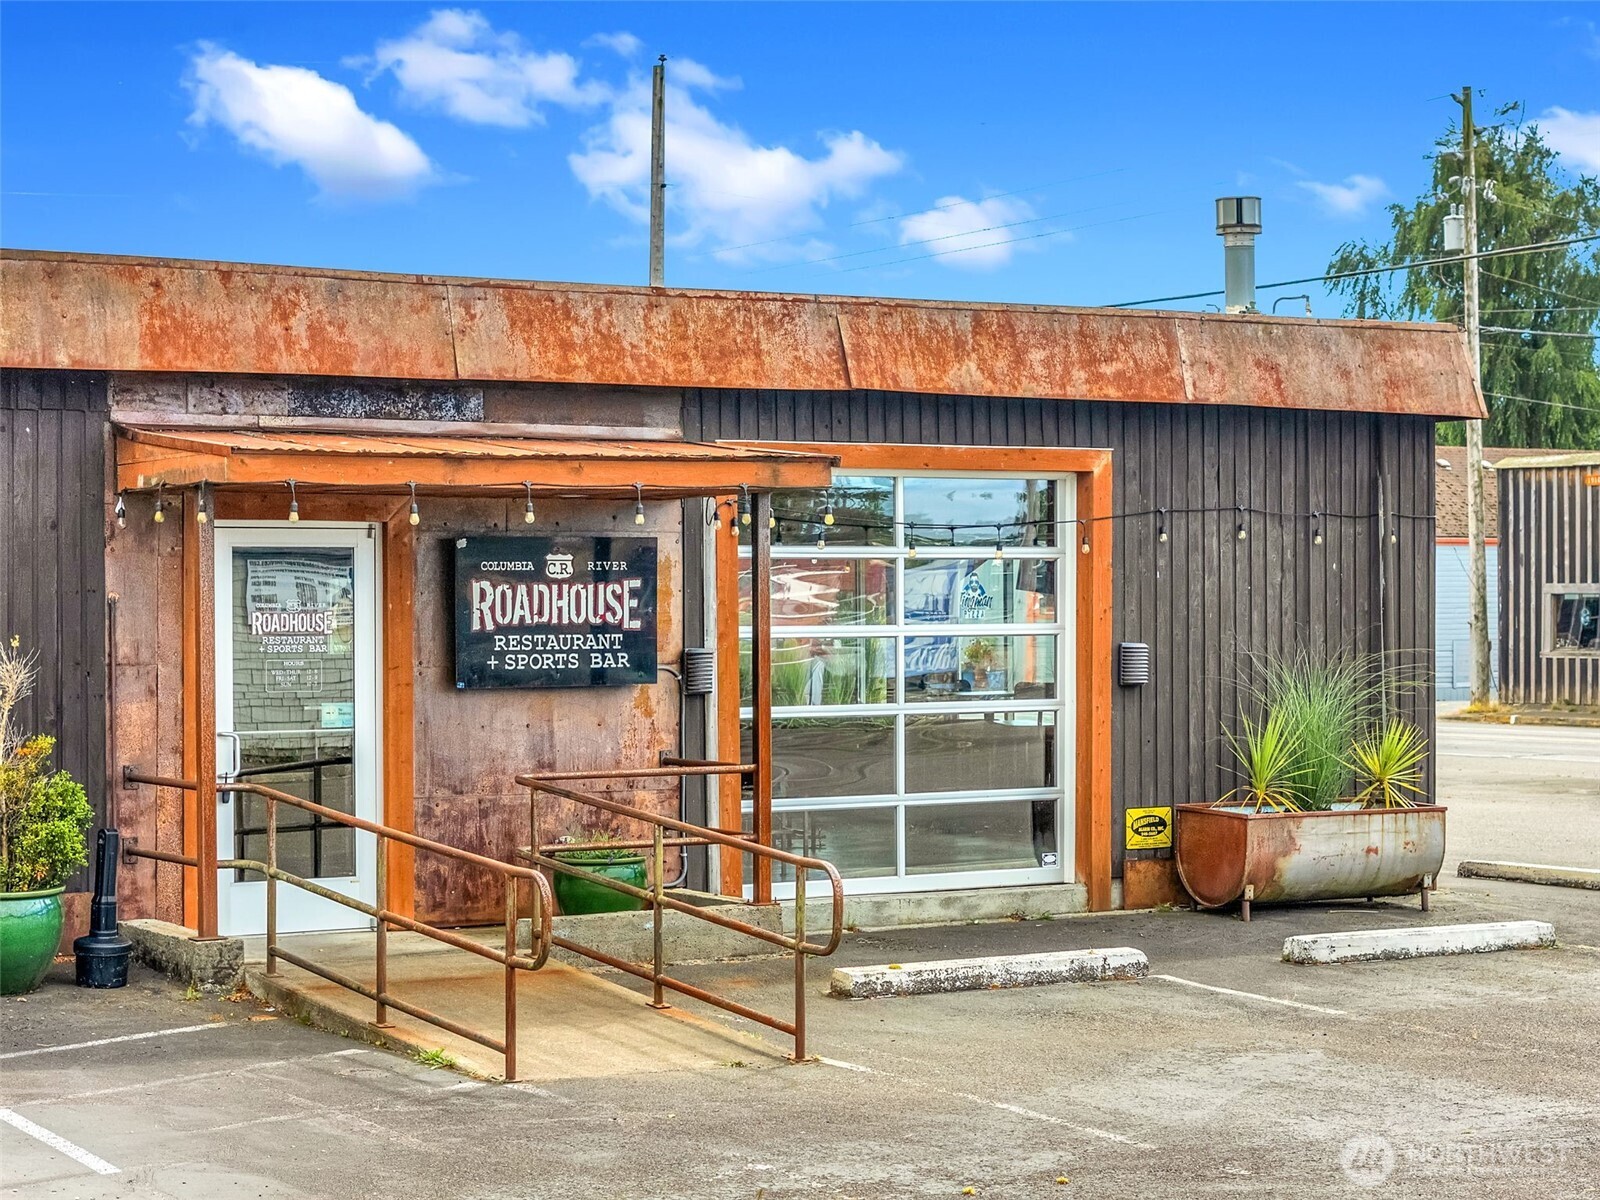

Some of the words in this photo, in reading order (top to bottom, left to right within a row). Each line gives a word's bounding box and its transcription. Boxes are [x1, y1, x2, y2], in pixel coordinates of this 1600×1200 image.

[480, 561, 535, 571] COLUMBIA
[547, 562, 572, 575] C.R.
[587, 561, 628, 571] RIVER
[471, 578, 642, 631] ROADHOUSE
[251, 611, 333, 635] ROADHOUSE
[262, 636, 325, 645] RESTAURANT
[266, 645, 304, 653] SPORTS
[309, 645, 328, 653] BAR
[494, 634, 623, 651] RESTAURANT
[504, 654, 579, 670] SPORTS
[590, 653, 630, 669] BAR
